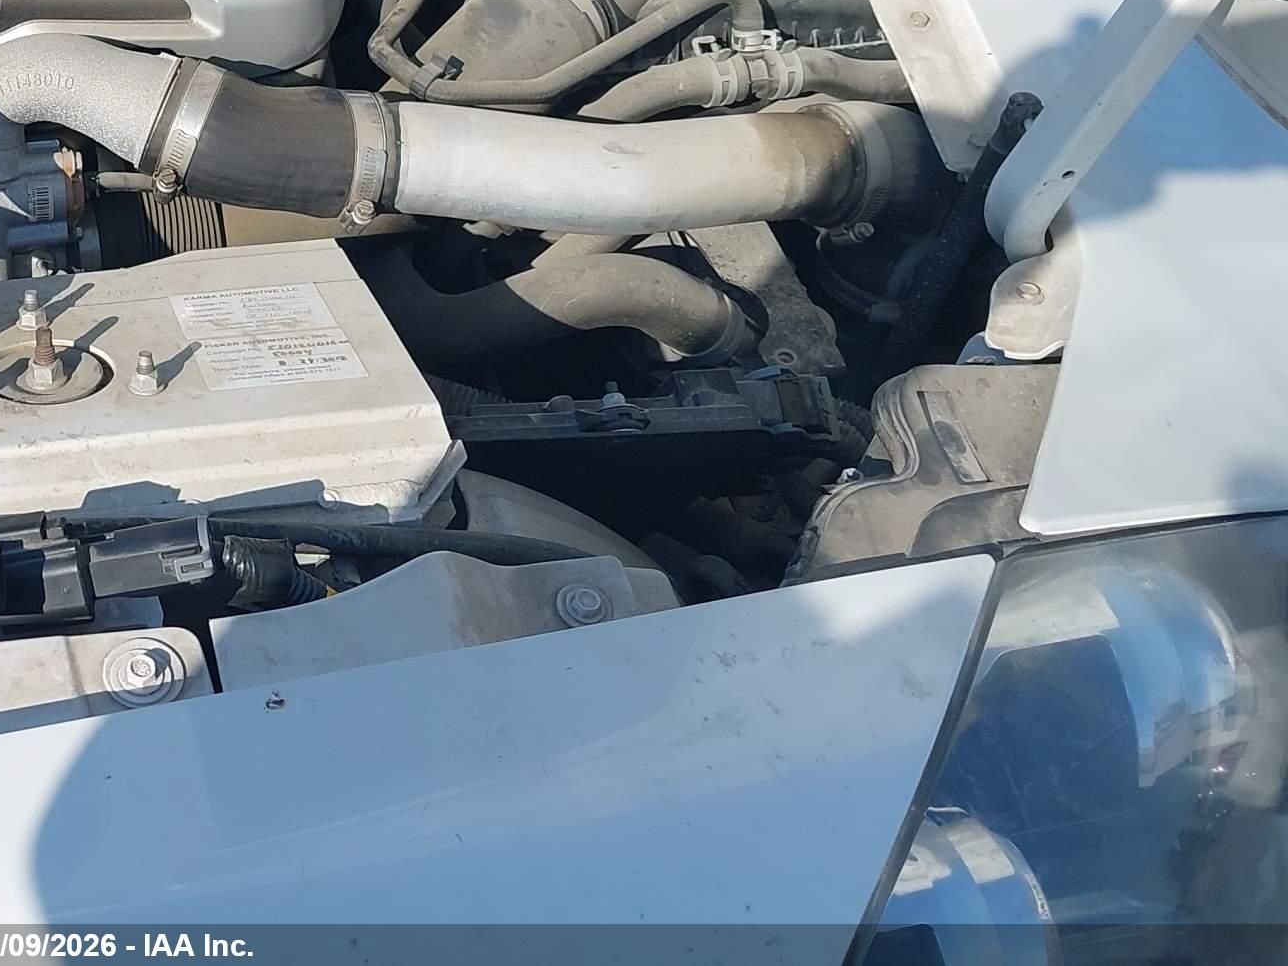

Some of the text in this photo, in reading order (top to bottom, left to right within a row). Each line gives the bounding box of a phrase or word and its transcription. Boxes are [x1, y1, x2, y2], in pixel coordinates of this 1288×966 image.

[183, 293, 218, 301] KARMA
[219, 288, 280, 298] AUTOMOTIVE
[203, 341, 241, 349] FISKER
